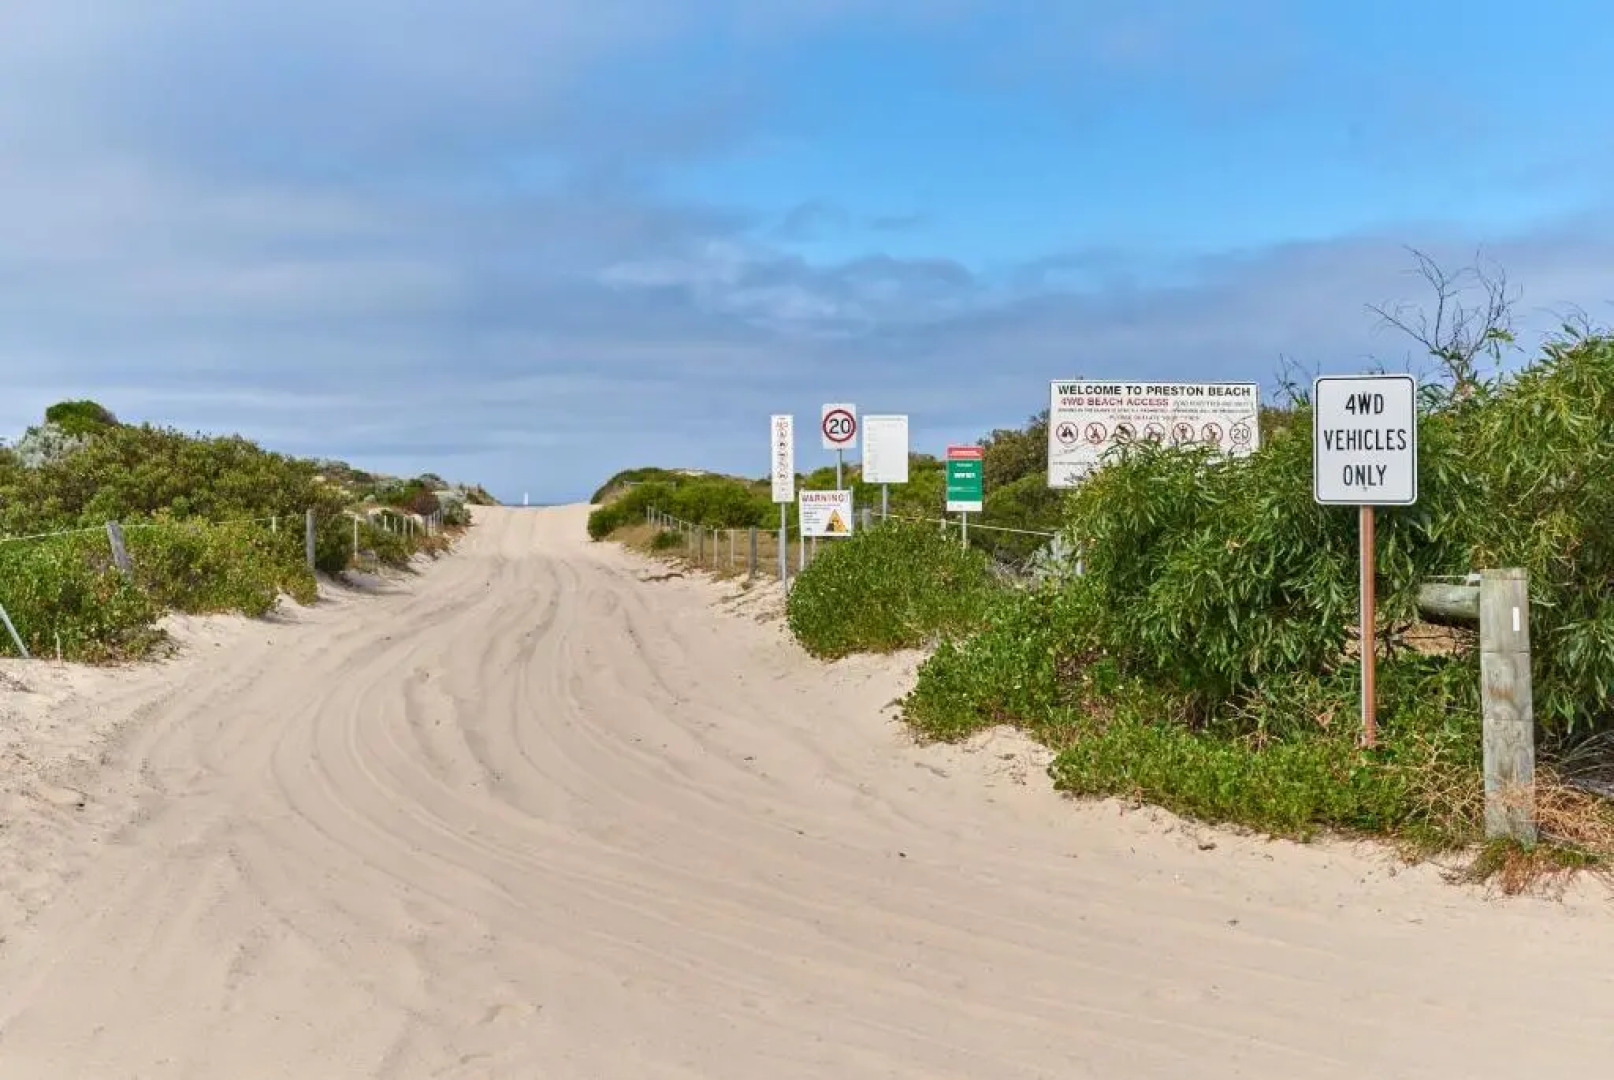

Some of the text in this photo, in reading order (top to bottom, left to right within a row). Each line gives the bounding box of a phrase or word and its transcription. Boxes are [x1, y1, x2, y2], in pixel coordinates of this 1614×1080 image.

[1058, 385, 1251, 396] WELCOME TO PRESTON BEACH
[1061, 397, 1085, 406] 4WD
[1087, 397, 1123, 406] BEACH
[1126, 397, 1169, 406] ACCESS
[1345, 393, 1384, 415] 4WD
[829, 418, 850, 434] 20
[1233, 428, 1249, 439] 20
[1324, 429, 1407, 451] VEHICLES
[1342, 464, 1387, 486] ONLY
